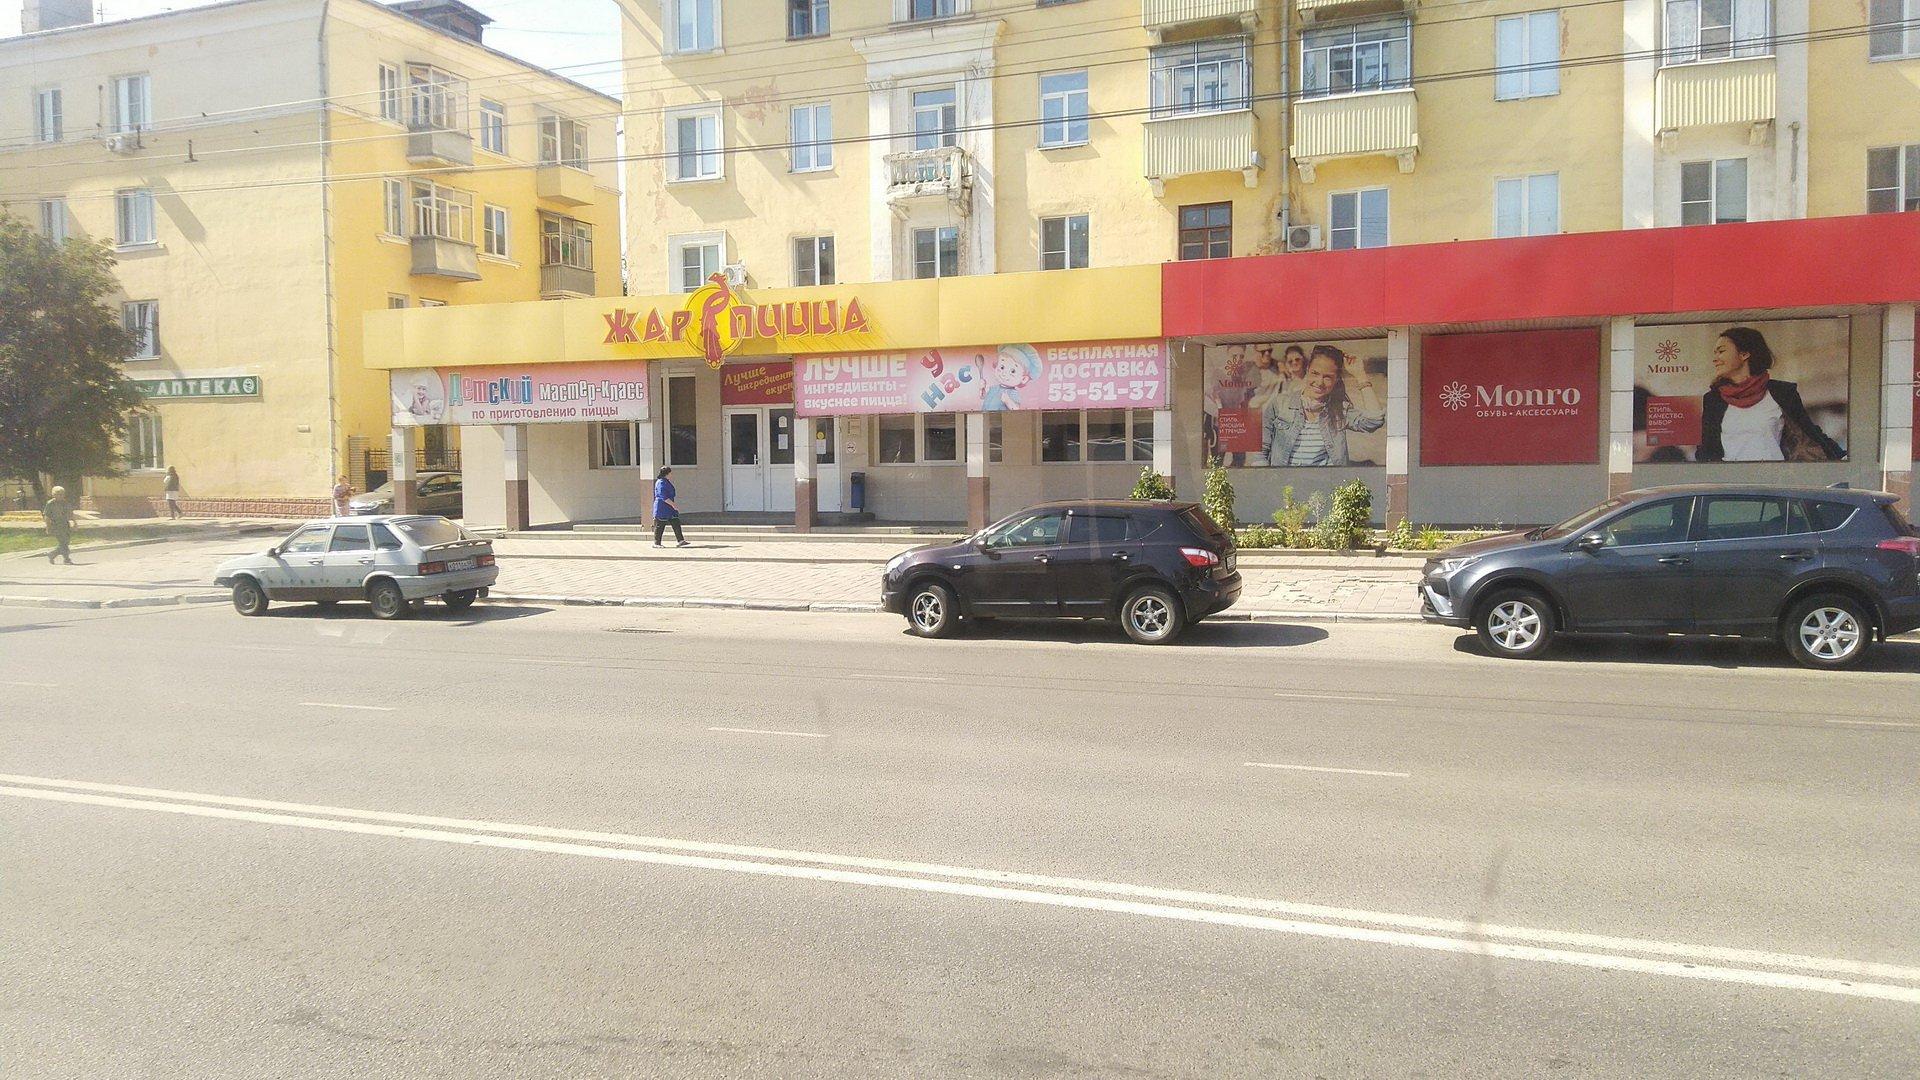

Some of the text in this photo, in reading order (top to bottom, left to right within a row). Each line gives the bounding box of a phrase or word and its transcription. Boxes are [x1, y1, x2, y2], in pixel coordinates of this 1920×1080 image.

[604, 296, 871, 343] ЖАР ПИЦЦА
[1047, 344, 1158, 360] БЕСПЛАТНАЯ
[724, 366, 767, 386] Лучше
[803, 353, 907, 381] ЛУЧШЕ
[1049, 360, 1158, 381] ДОСТАВКА
[1648, 364, 1689, 373] Monro
[156, 378, 240, 396] АПТЕКА
[1048, 380, 1158, 402] 53-51-37
[1474, 384, 1581, 407] Monro
[472, 405, 618, 421] по приготовлению пиццы
[1476, 408, 1578, 418] ОБУВЬ АКСЕССУАРЫ
